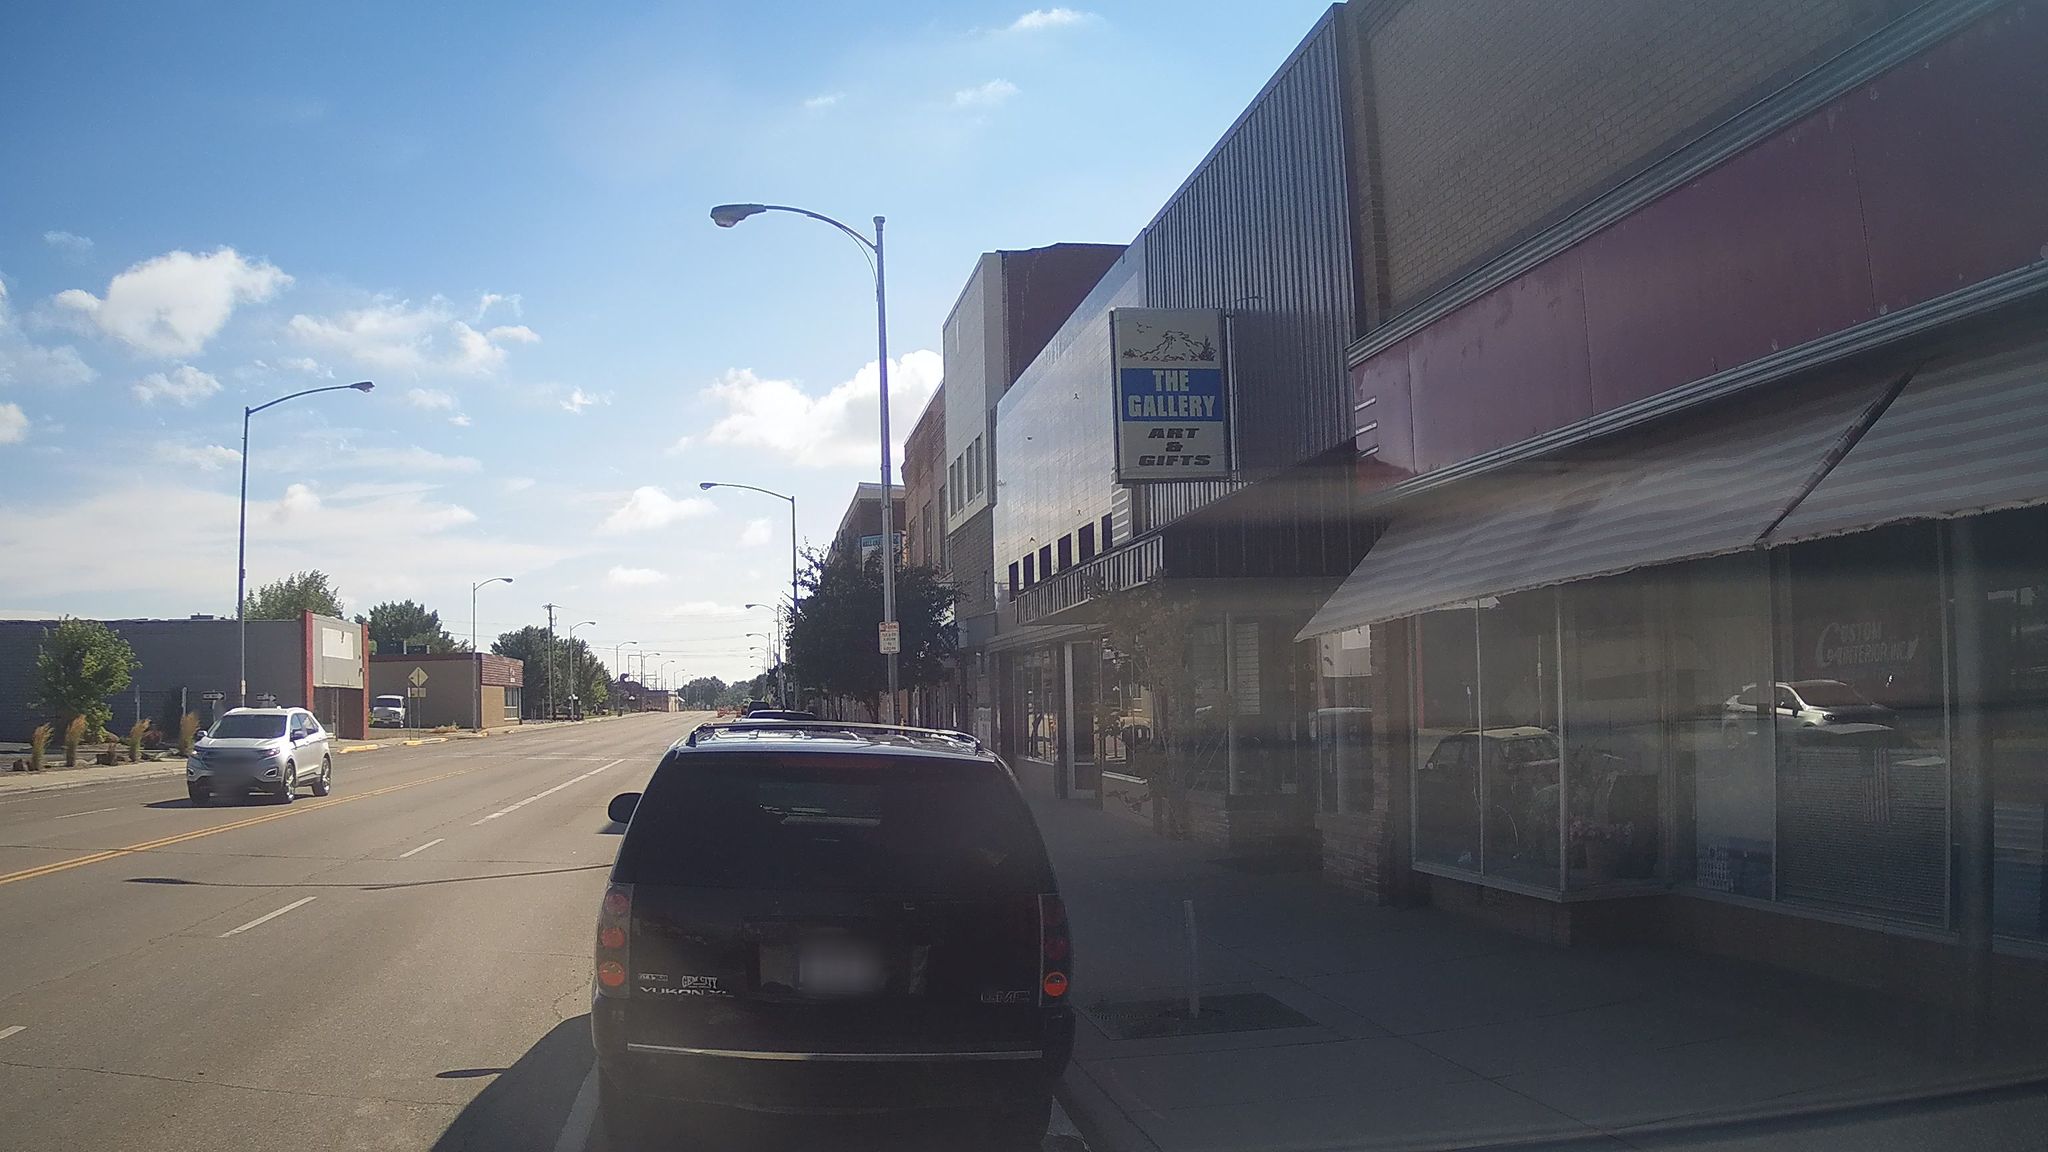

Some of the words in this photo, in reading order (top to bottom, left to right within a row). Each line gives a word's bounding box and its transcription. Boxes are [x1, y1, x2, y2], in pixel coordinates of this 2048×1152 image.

[1152, 369, 1190, 392] THE
[1127, 395, 1217, 417] GALLERY
[1148, 427, 1200, 439] ART
[1165, 441, 1184, 453] &
[1138, 454, 1212, 466] GIFTS
